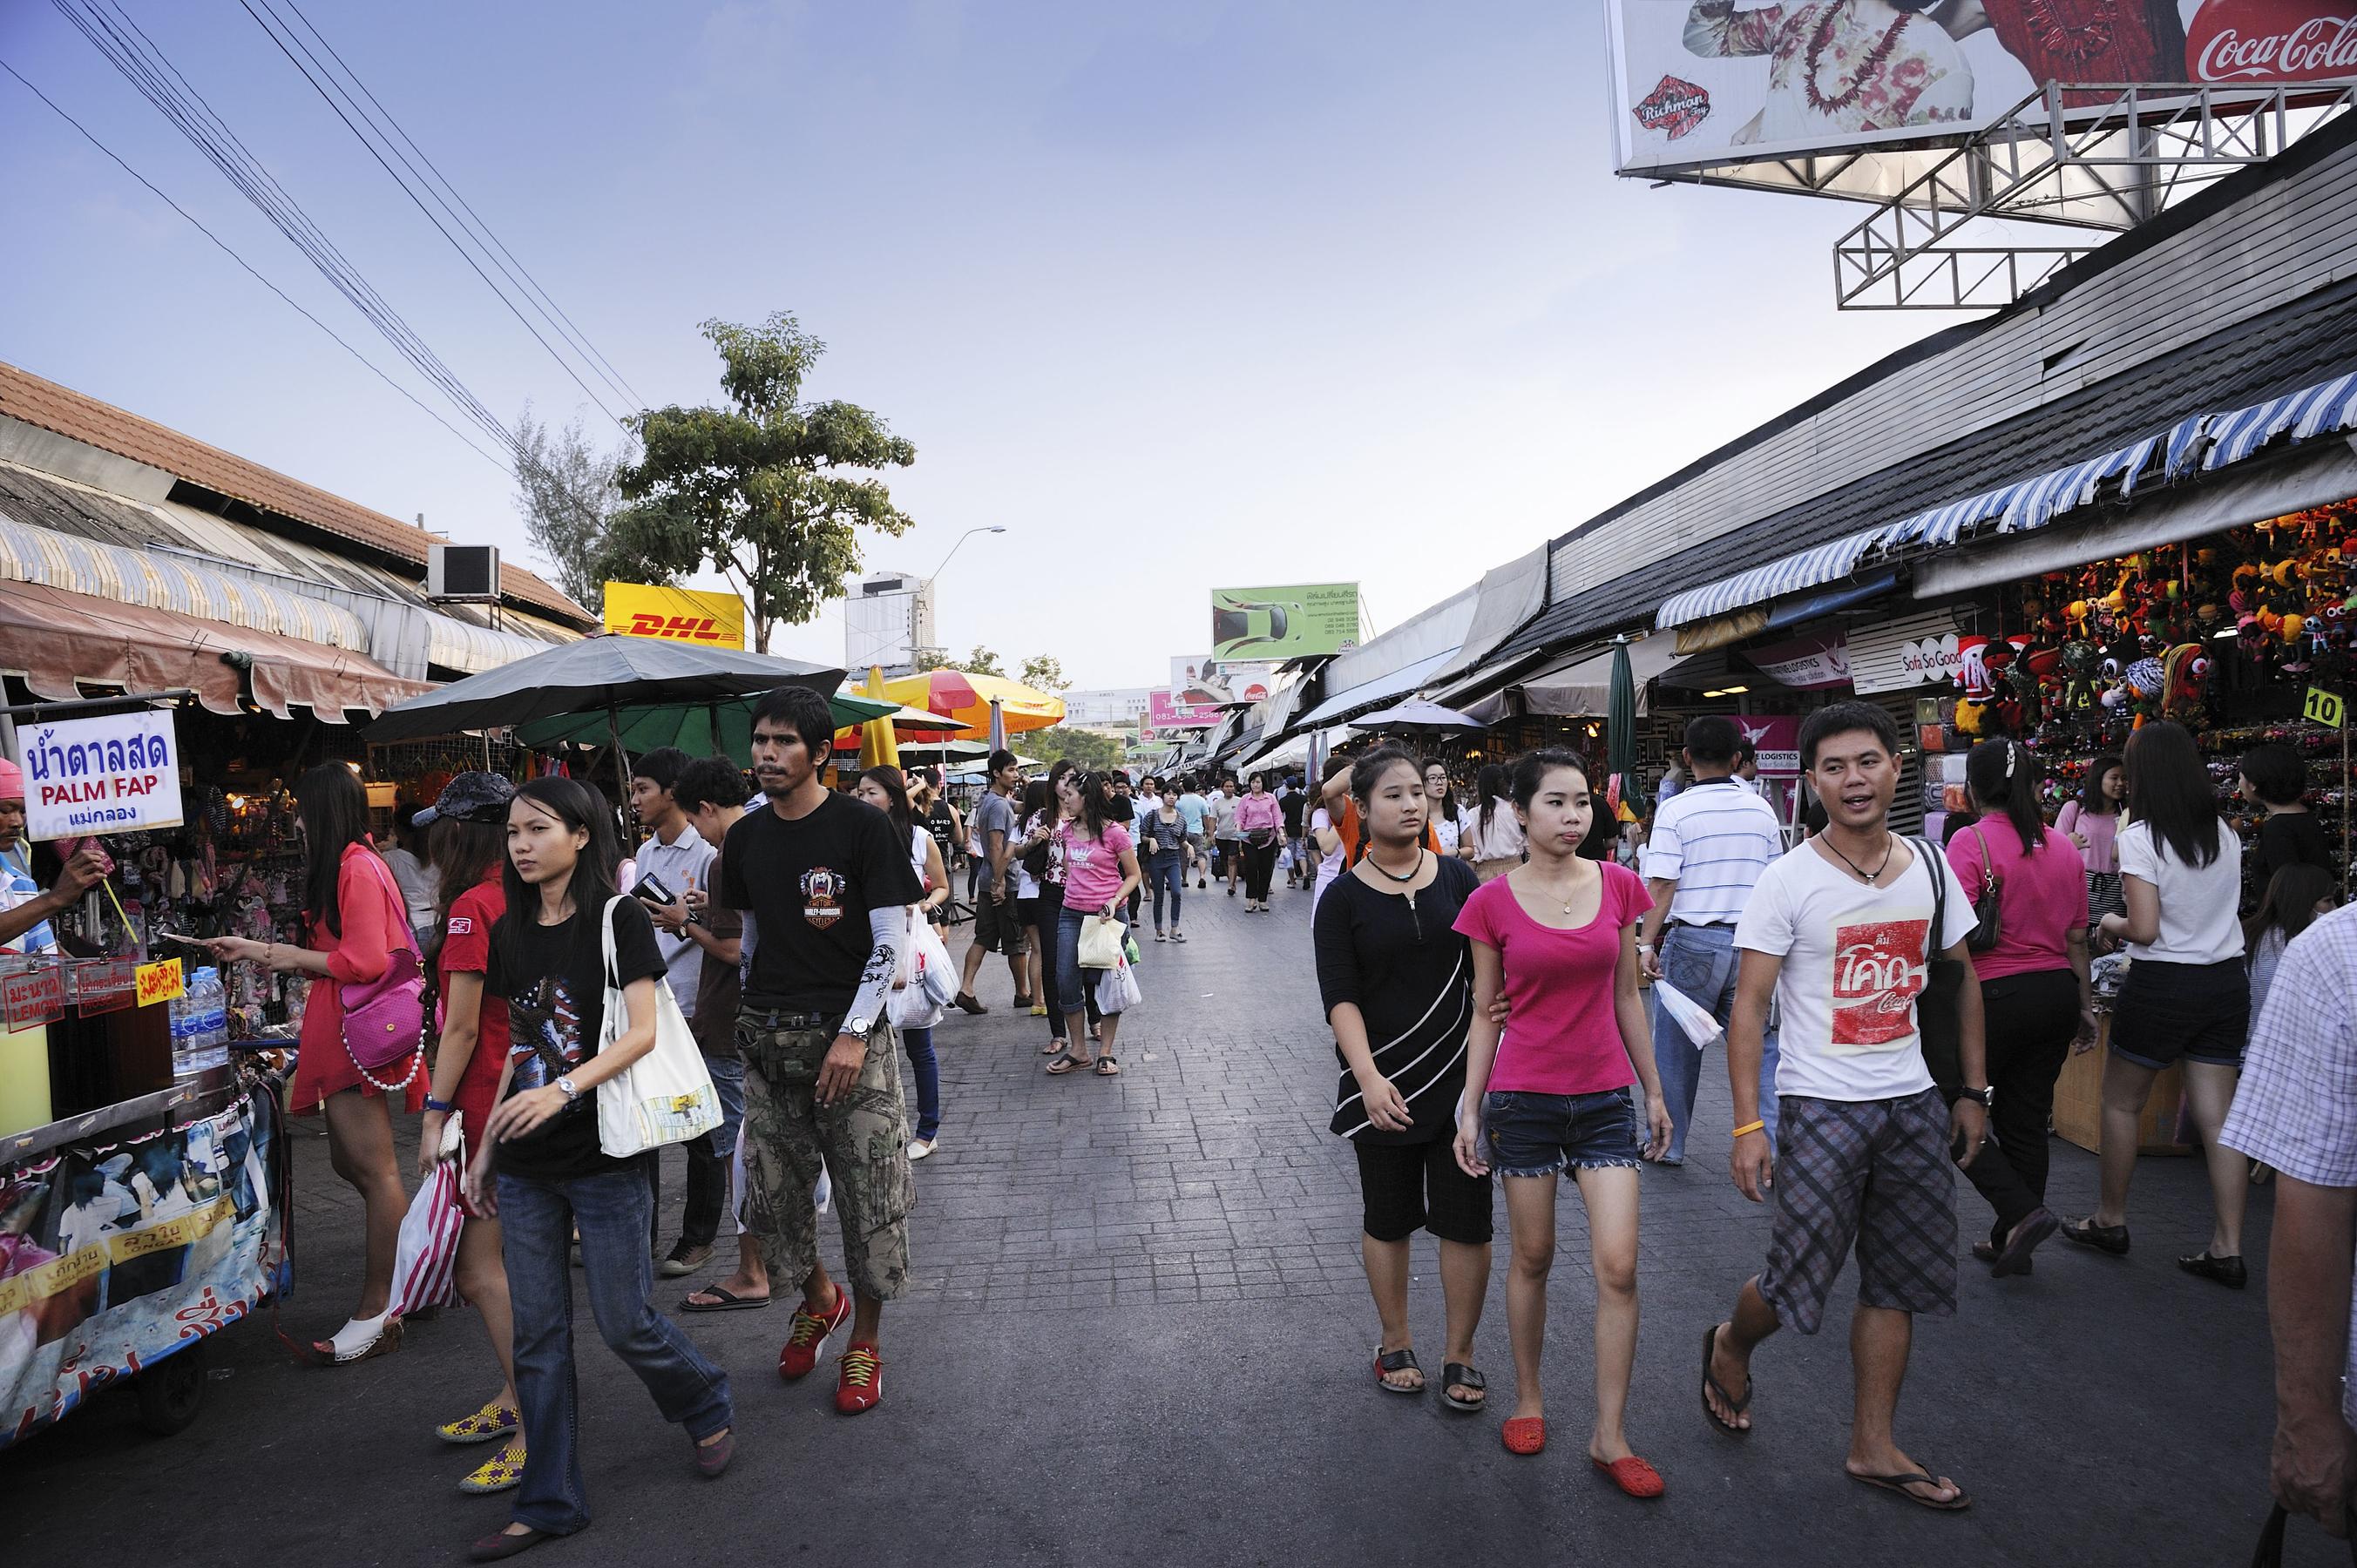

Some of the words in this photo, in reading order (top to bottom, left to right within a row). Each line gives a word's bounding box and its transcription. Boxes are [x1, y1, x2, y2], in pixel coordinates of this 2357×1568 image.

[2198, 15, 2357, 81] Coca-Cola
[1642, 95, 1704, 122] Richman
[629, 613, 721, 639] DHL
[1789, 658, 1819, 673] LOGISTICS
[1903, 655, 1923, 671] Sofa
[1922, 653, 1935, 668] So
[1935, 651, 1962, 666] Good
[2308, 693, 2336, 721] 10
[27, 728, 168, 781] น้ำตาลสด
[41, 780, 106, 806] PALM
[114, 774, 158, 798] FAP
[70, 807, 136, 826] แม่กลอง
[10, 979, 58, 1004] มะนาว
[12, 998, 58, 1023] LEMON
